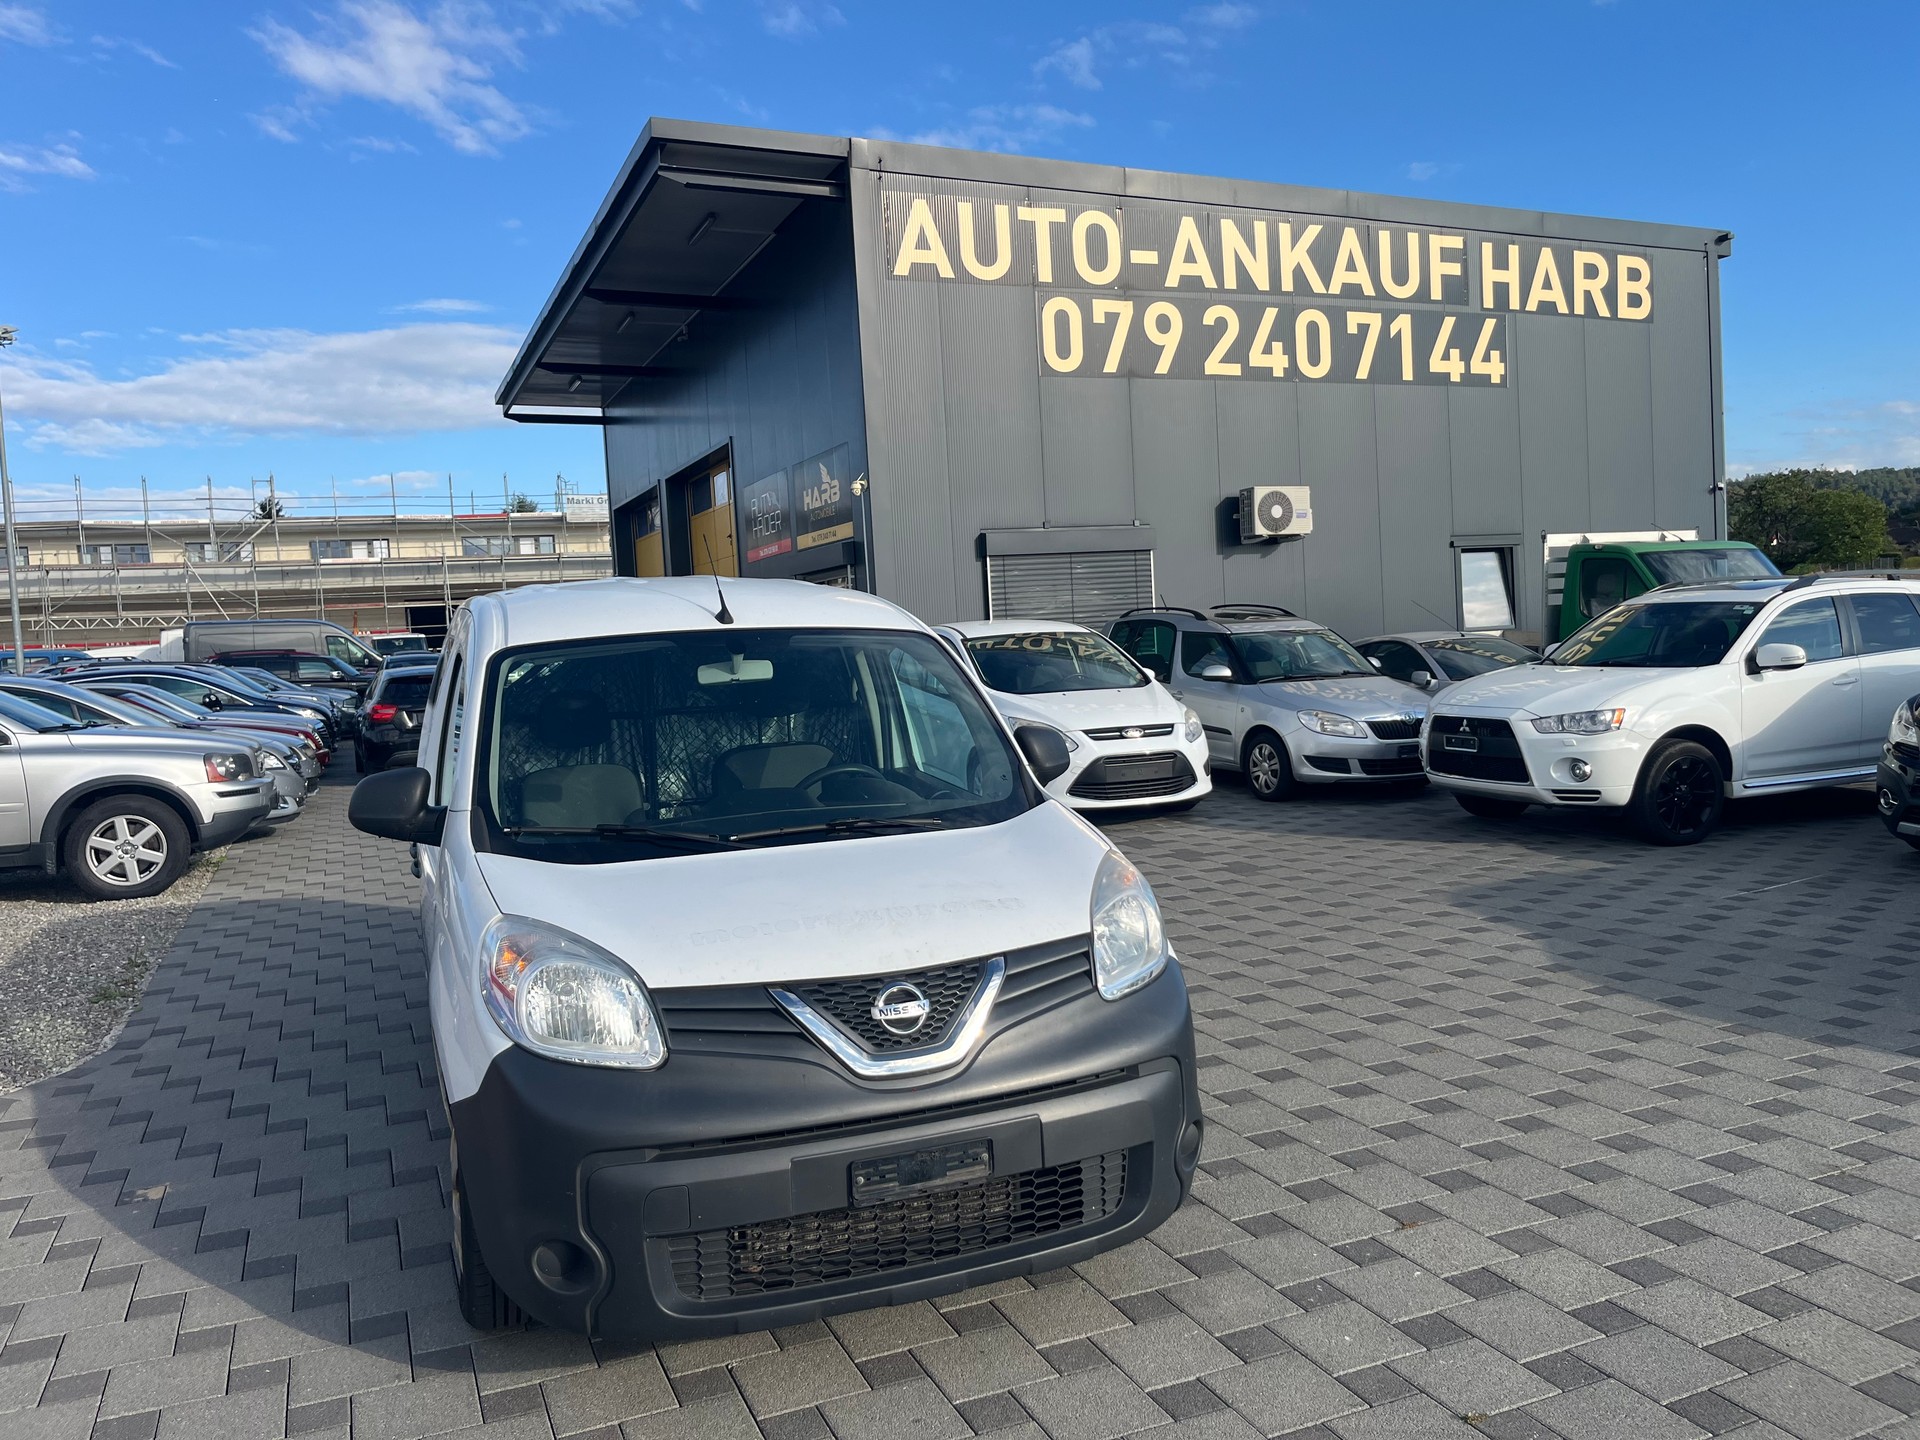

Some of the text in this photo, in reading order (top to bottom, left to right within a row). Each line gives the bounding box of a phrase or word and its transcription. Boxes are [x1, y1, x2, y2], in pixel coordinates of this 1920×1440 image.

[893, 198, 1654, 321] AUTO-ANKAUF HARB
[1041, 296, 1185, 376] 079
[1203, 304, 1332, 380] 240
[566, 496, 594, 505] Marki
[803, 479, 841, 511] HARB
[878, 1002, 927, 1018] NISSN
